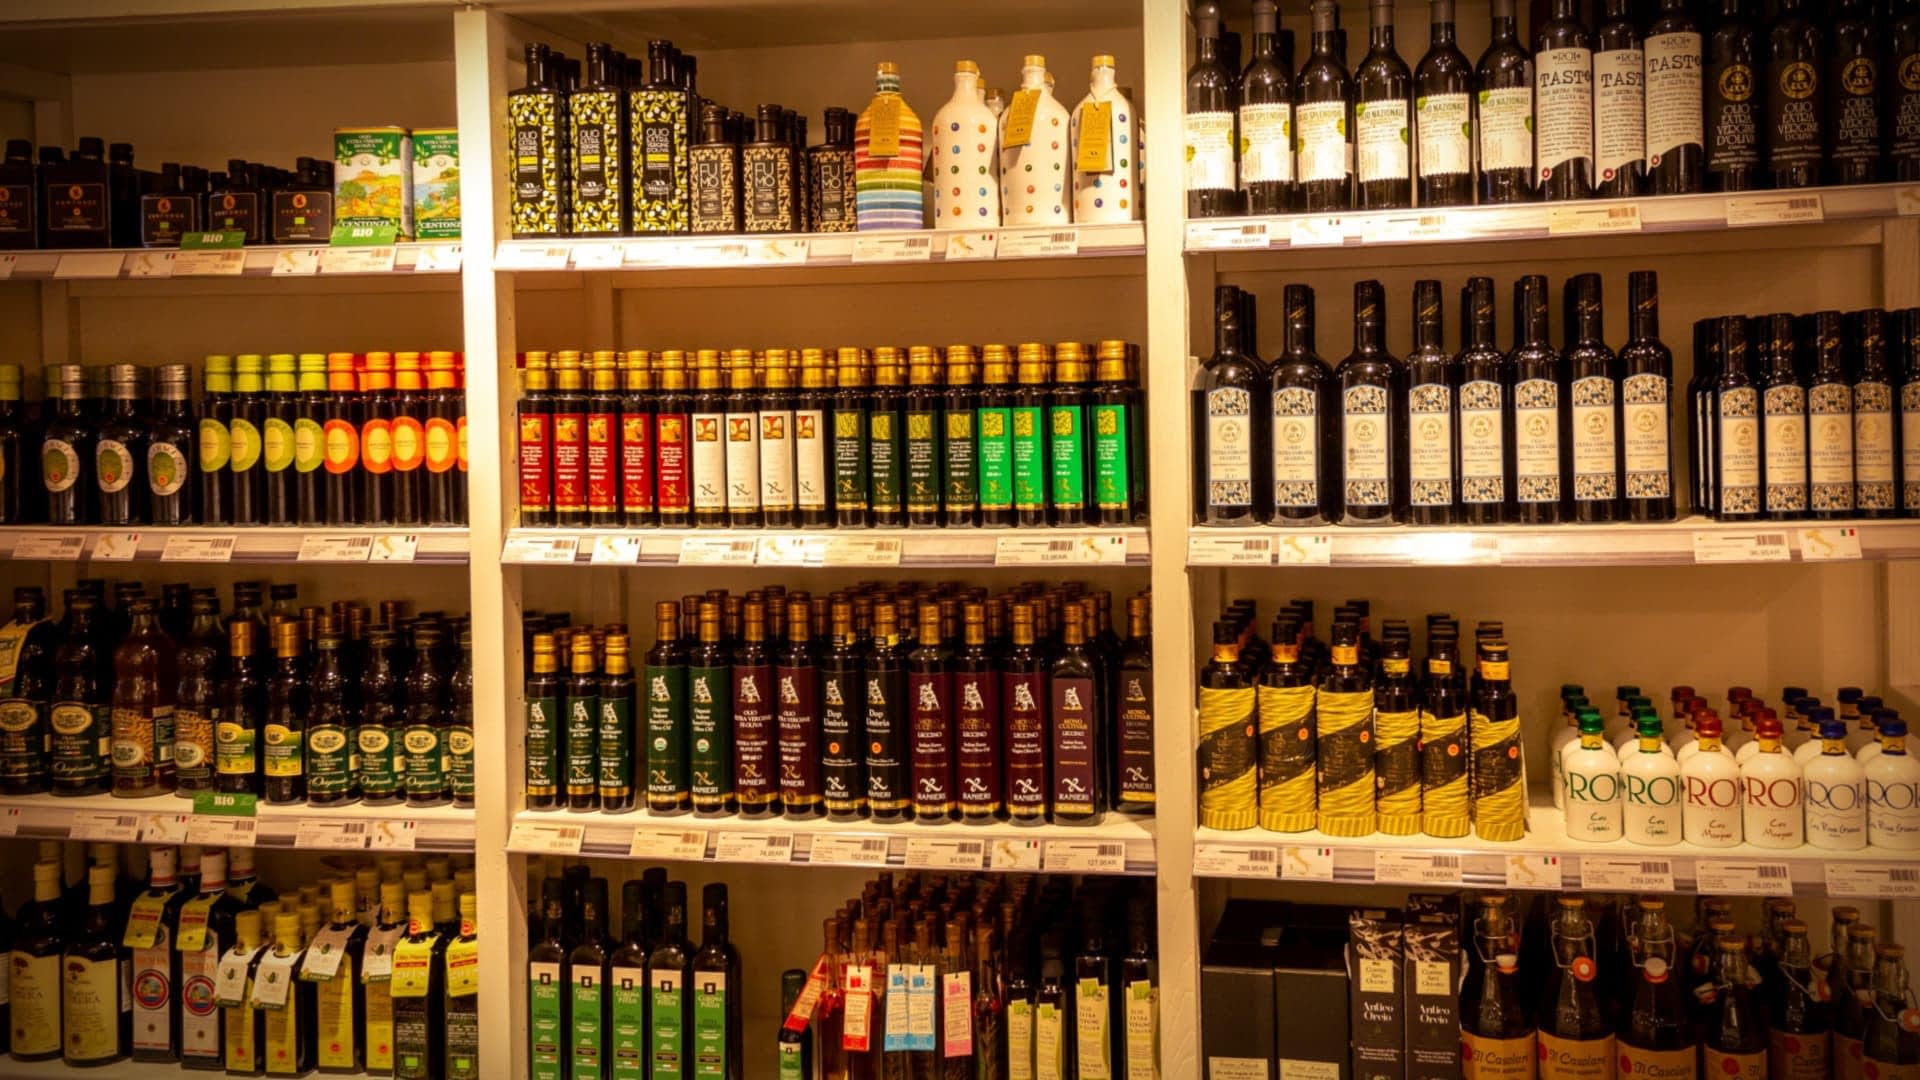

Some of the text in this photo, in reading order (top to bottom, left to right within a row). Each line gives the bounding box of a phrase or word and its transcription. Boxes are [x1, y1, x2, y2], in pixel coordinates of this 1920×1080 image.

[420, 222, 461, 230] CENTONZ
[351, 226, 373, 237] BIO
[202, 233, 223, 243] BIO
[214, 795, 235, 806] BIO
